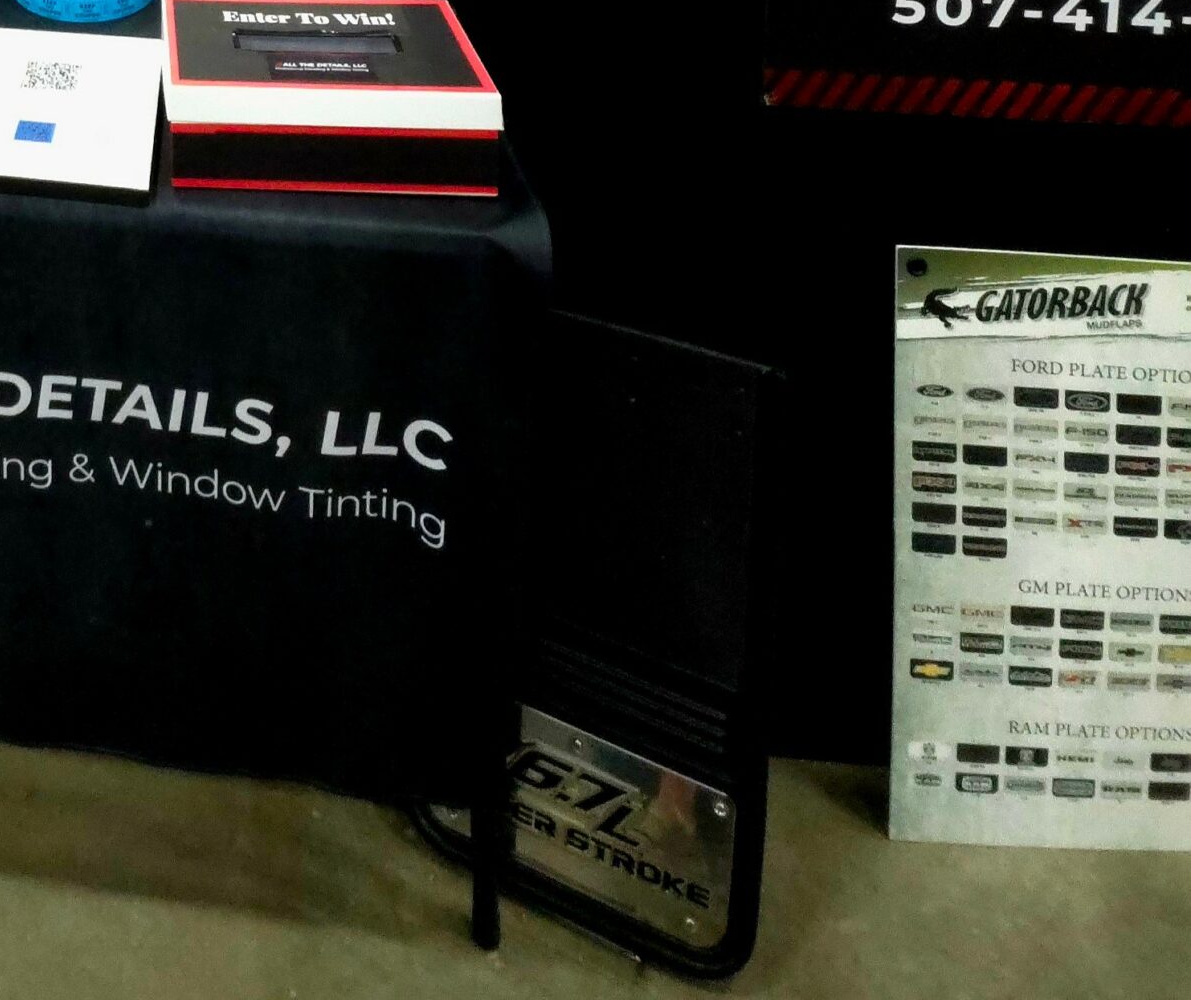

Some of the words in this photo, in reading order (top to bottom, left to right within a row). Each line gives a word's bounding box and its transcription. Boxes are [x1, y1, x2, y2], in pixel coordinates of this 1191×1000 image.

[222, 9, 291, 25] Enter
[295, 12, 330, 26] To
[333, 12, 396, 27] Win!
[974, 283, 1150, 323] GATORBACK
[1086, 319, 1143, 331] MUDFLAPS
[1011, 358, 1064, 375] FORD
[1069, 363, 1129, 381] PLATE
[320, 410, 454, 471] LLC
[68, 452, 96, 483] &
[109, 455, 287, 513] Window
[298, 485, 446, 549] Tinting
[1018, 579, 1049, 595] GM
[1055, 582, 1110, 599] PLATE
[1009, 720, 1050, 735] RAM
[1056, 723, 1110, 739] PLATE
[513, 750, 641, 848] 6.7L
[565, 827, 711, 910] STROKE
